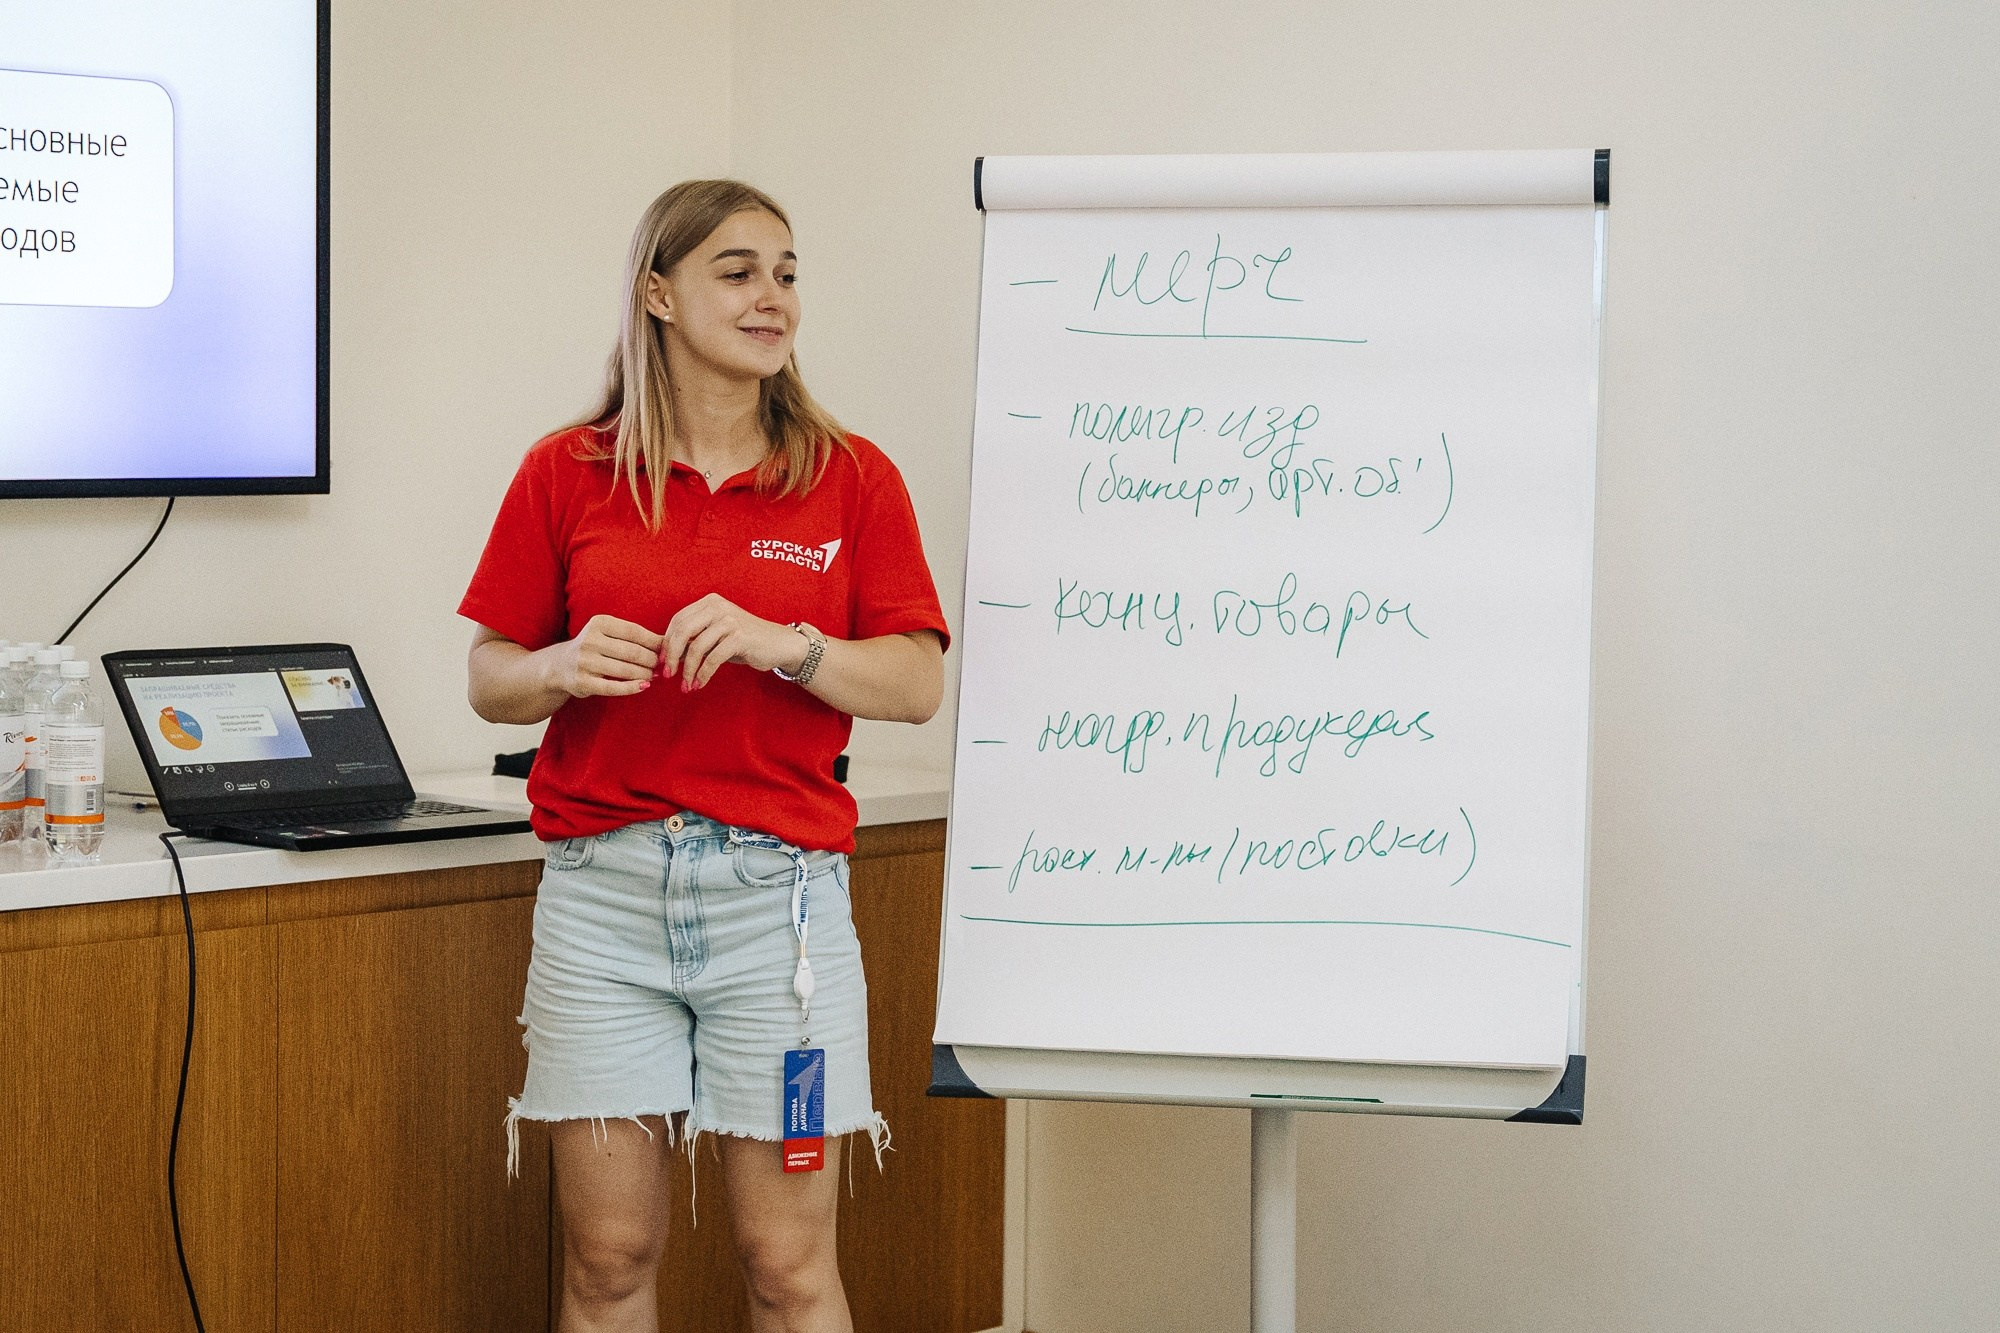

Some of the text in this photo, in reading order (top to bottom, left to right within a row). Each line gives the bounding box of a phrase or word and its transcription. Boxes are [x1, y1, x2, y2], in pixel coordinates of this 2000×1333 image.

[750, 548, 821, 572] ОБЛАСТЬ
[751, 539, 824, 561] КУРСКАЯ
[800, 1102, 808, 1132] ДИАНА
